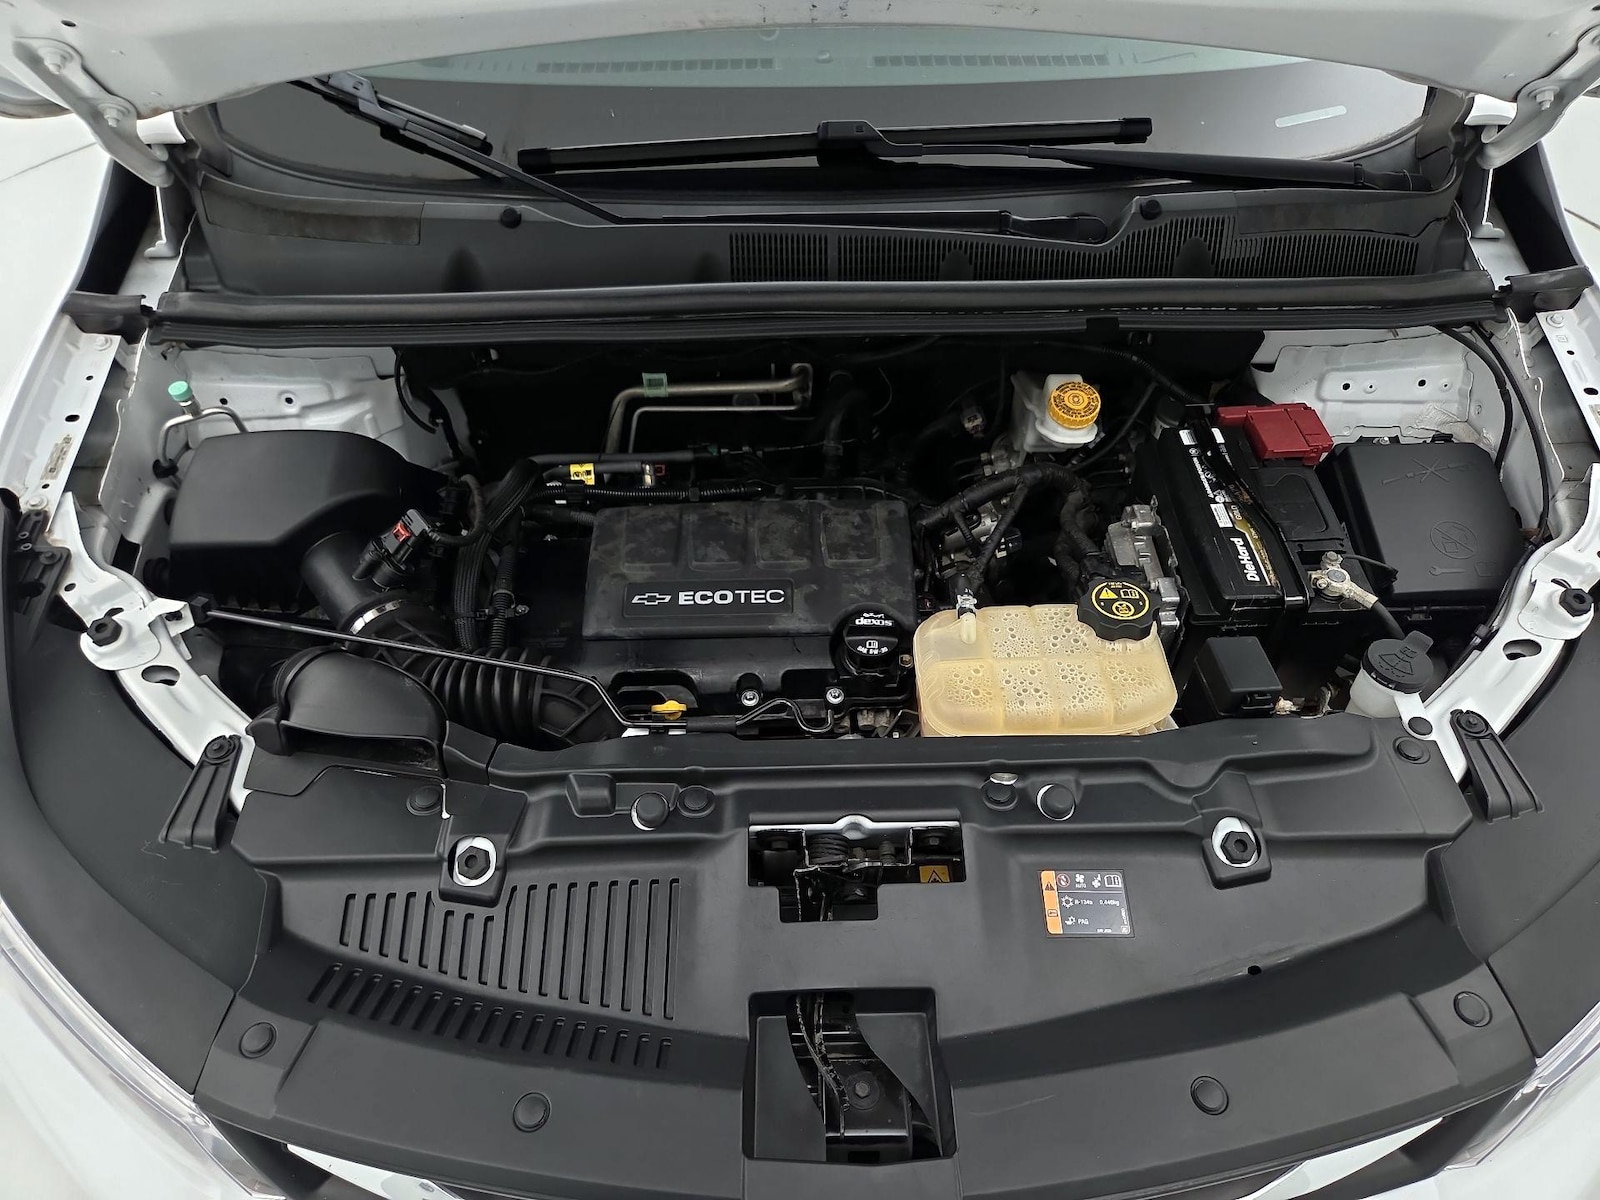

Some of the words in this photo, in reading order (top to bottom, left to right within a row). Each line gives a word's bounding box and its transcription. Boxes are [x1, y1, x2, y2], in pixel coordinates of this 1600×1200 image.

[1231, 505, 1242, 520] GOLD
[1230, 538, 1260, 582] DieHard
[678, 589, 785, 604] ECOTEC
[855, 617, 893, 626] dexos
